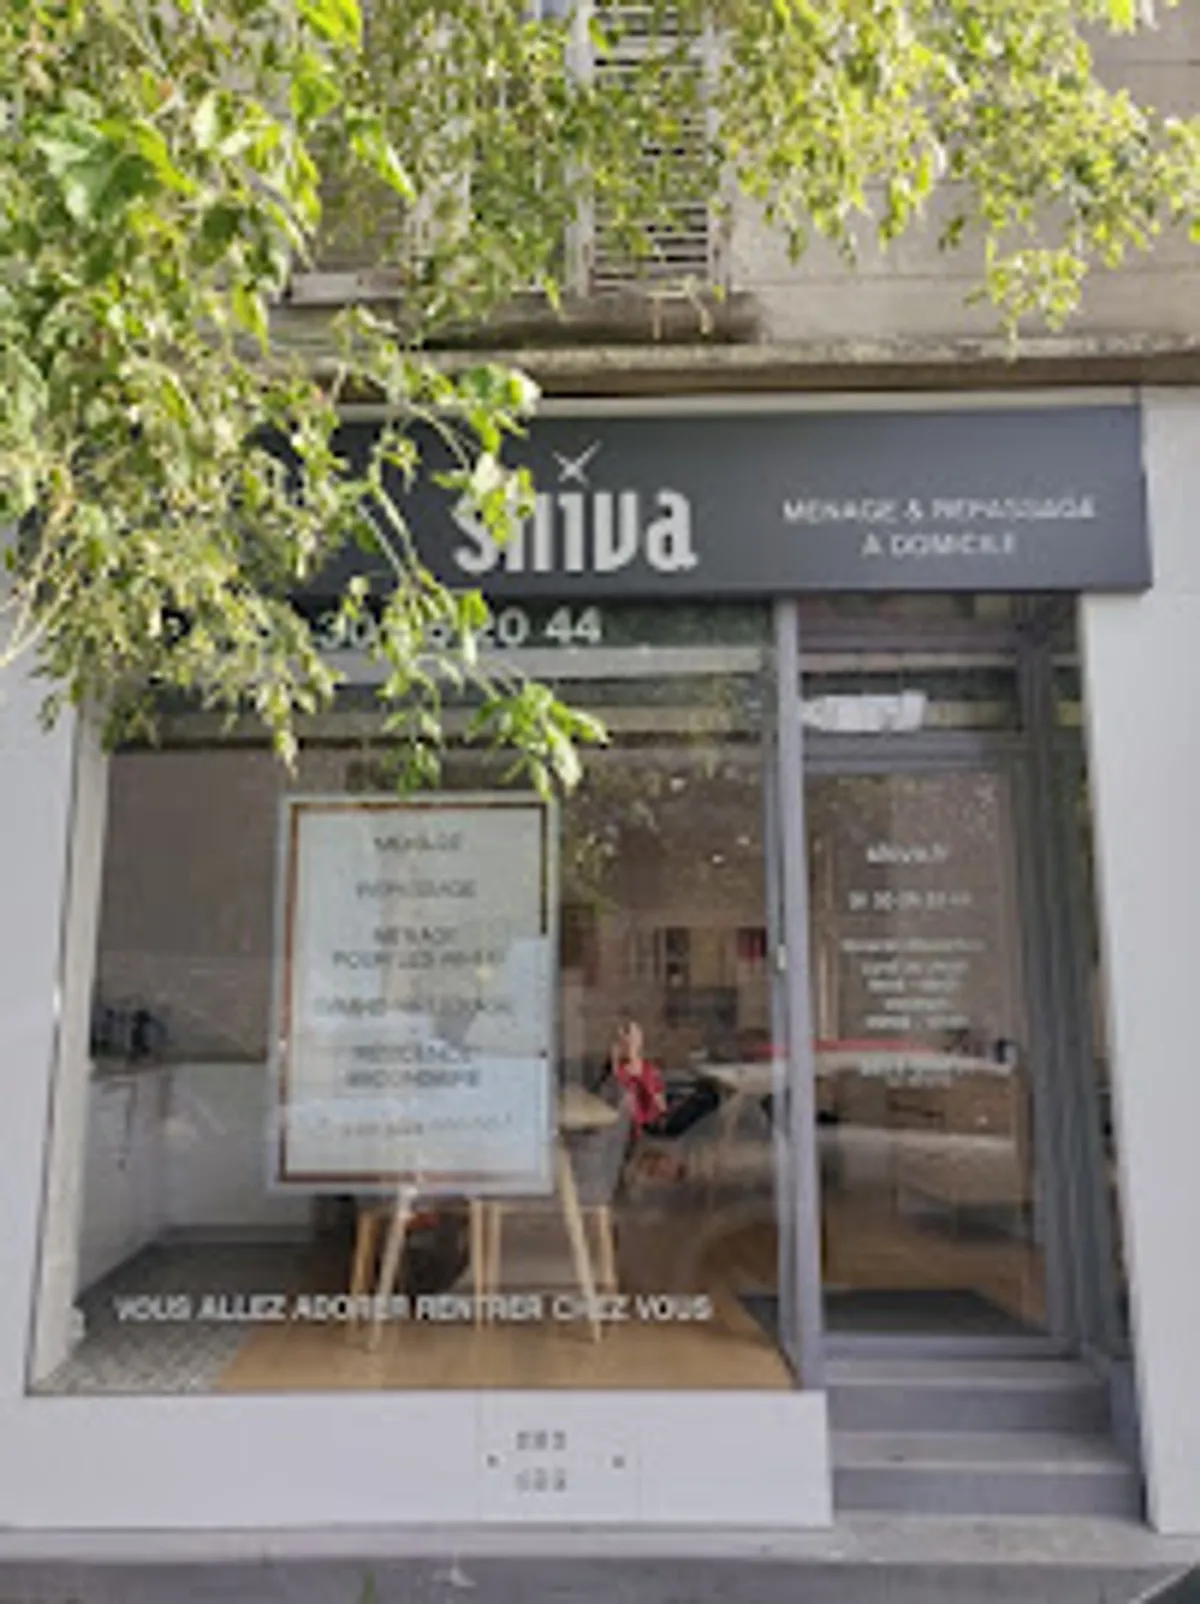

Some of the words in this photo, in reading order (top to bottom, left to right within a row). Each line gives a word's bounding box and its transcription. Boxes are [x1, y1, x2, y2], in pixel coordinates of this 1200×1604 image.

[544, 606, 602, 646] 44
[114, 1294, 191, 1321] VOUS
[197, 1294, 287, 1321] ALLEZ
[415, 1294, 543, 1321] RENTRER
[634, 1294, 713, 1321] VOUS
